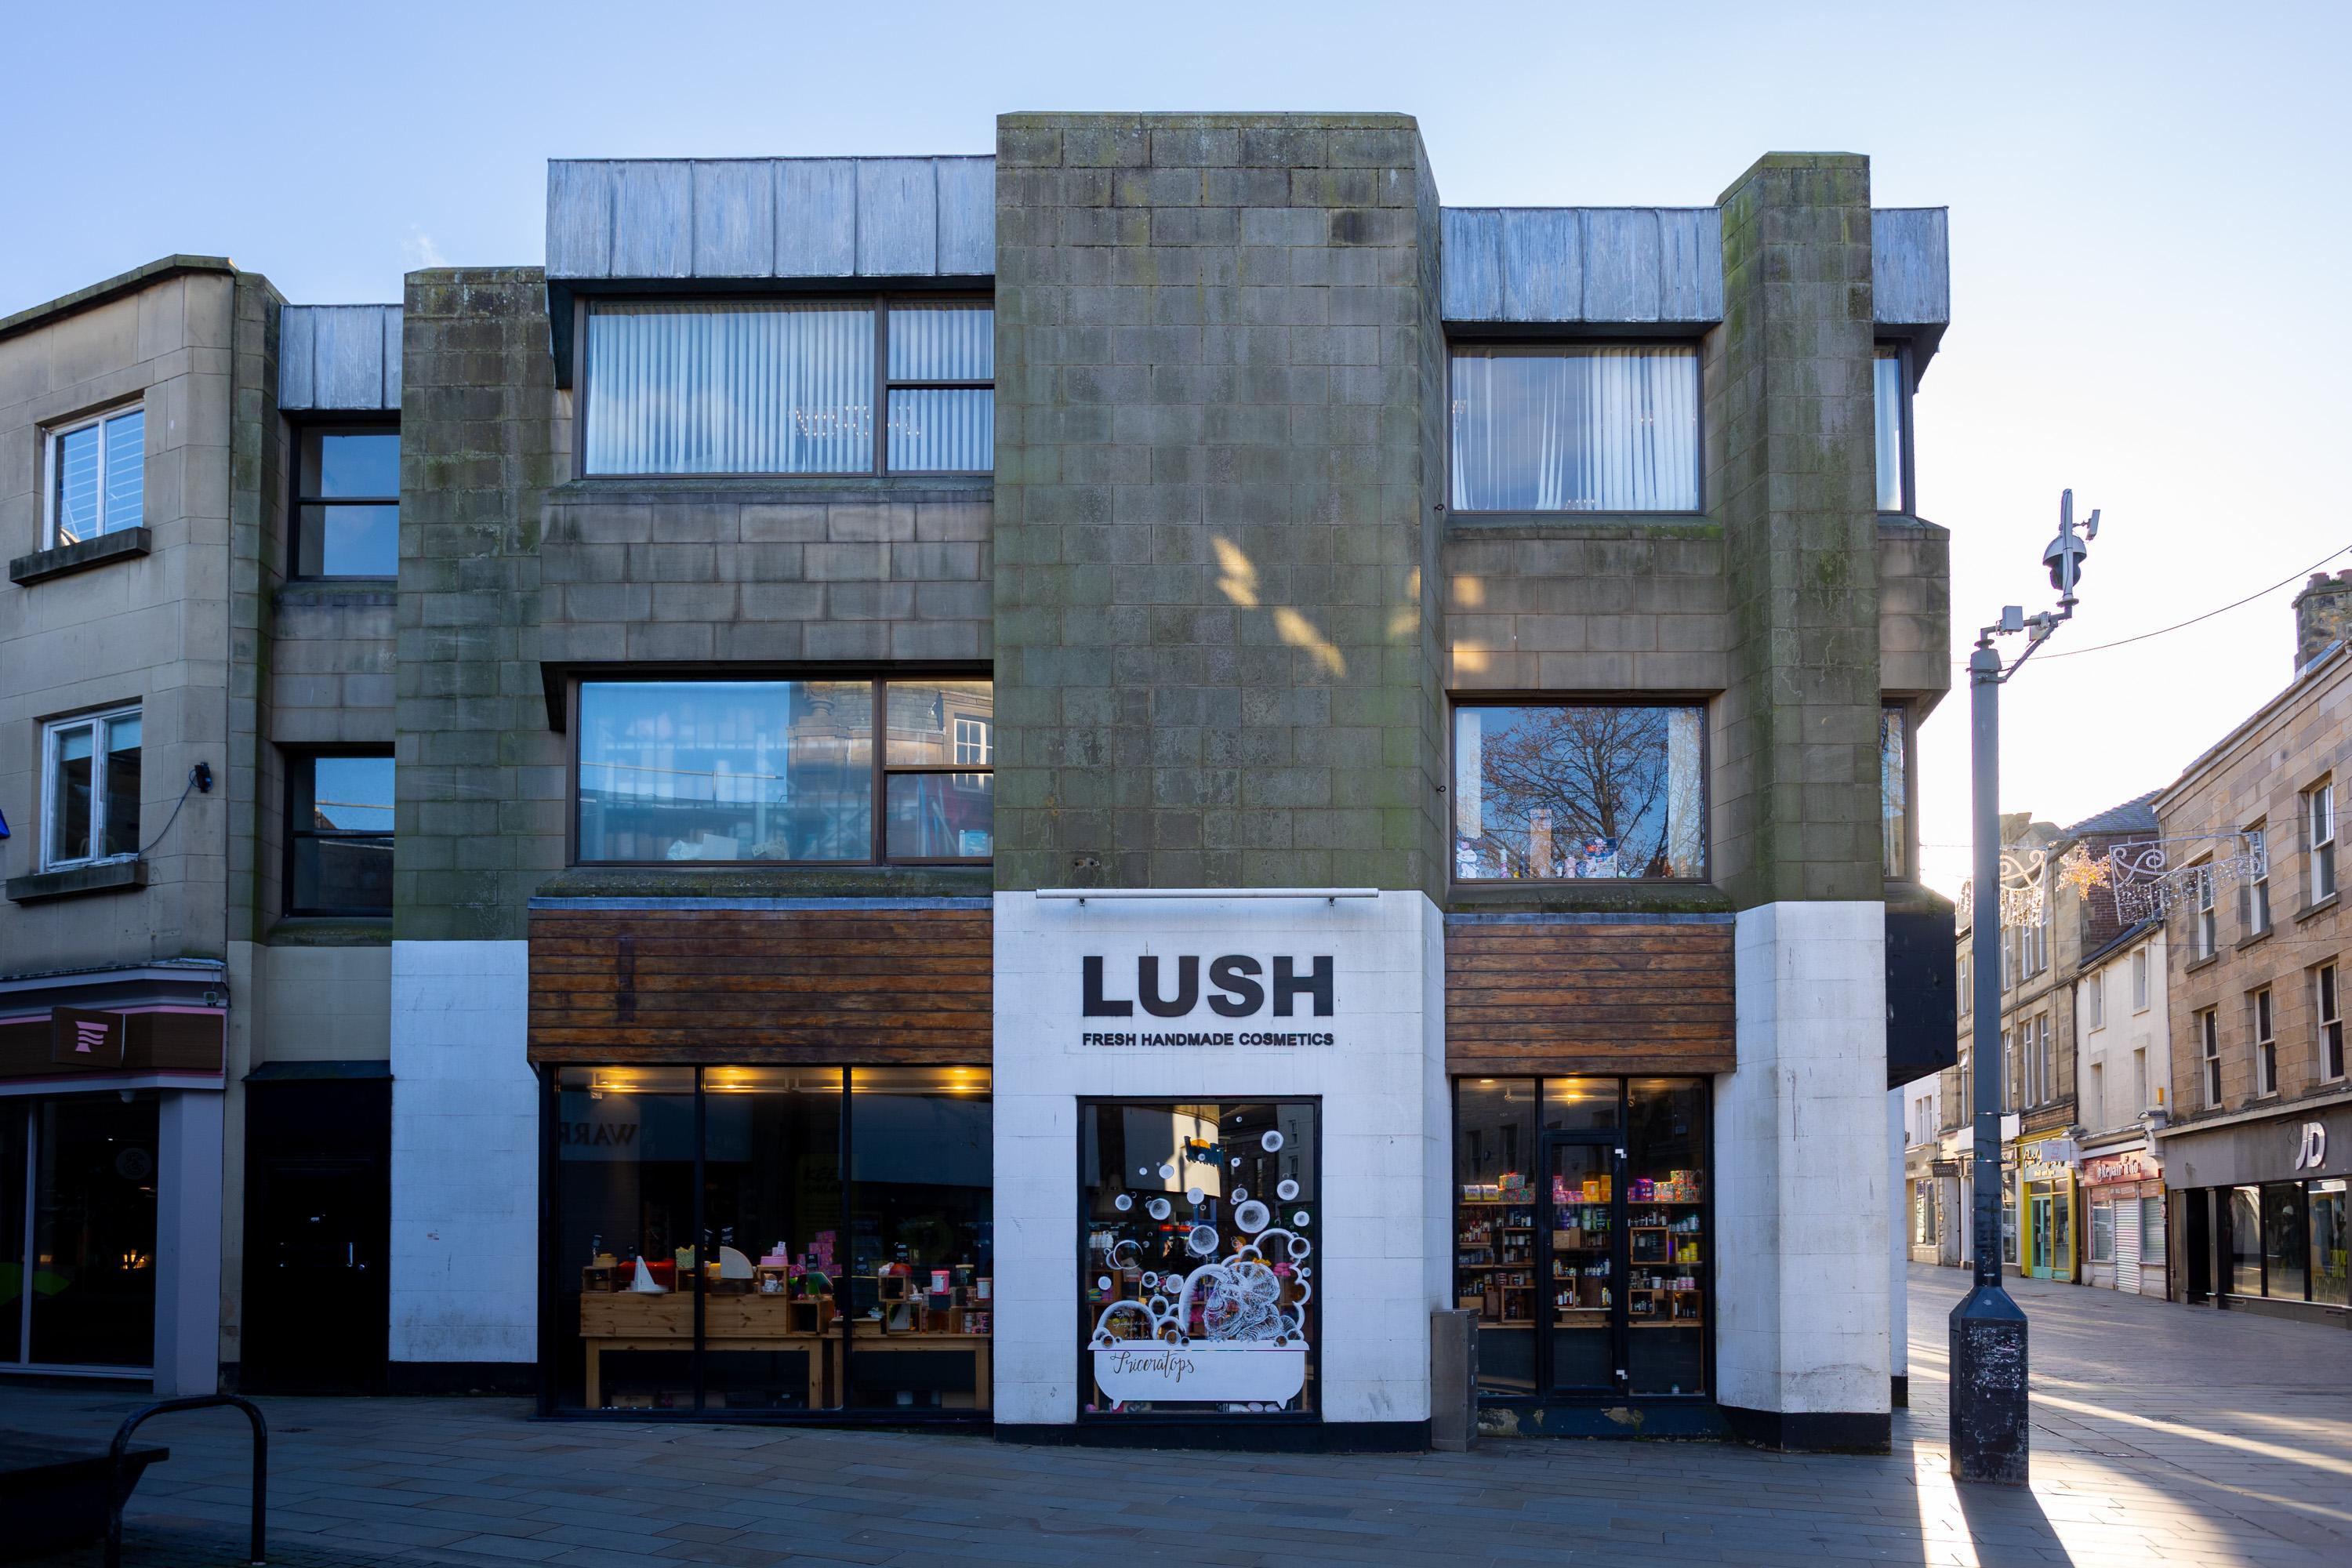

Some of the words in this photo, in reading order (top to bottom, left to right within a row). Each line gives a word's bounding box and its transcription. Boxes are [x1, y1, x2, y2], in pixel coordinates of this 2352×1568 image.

[1083, 955, 1334, 1017] LUSH
[1083, 1033, 1136, 1046] FRESH
[1142, 1033, 1234, 1046] HANDMADE
[1239, 1033, 1334, 1046] COSMETICS
[2296, 1122, 2325, 1171] JD
[2101, 1162, 2123, 1181] Repair
[1109, 1350, 1194, 1383] Triceratops
